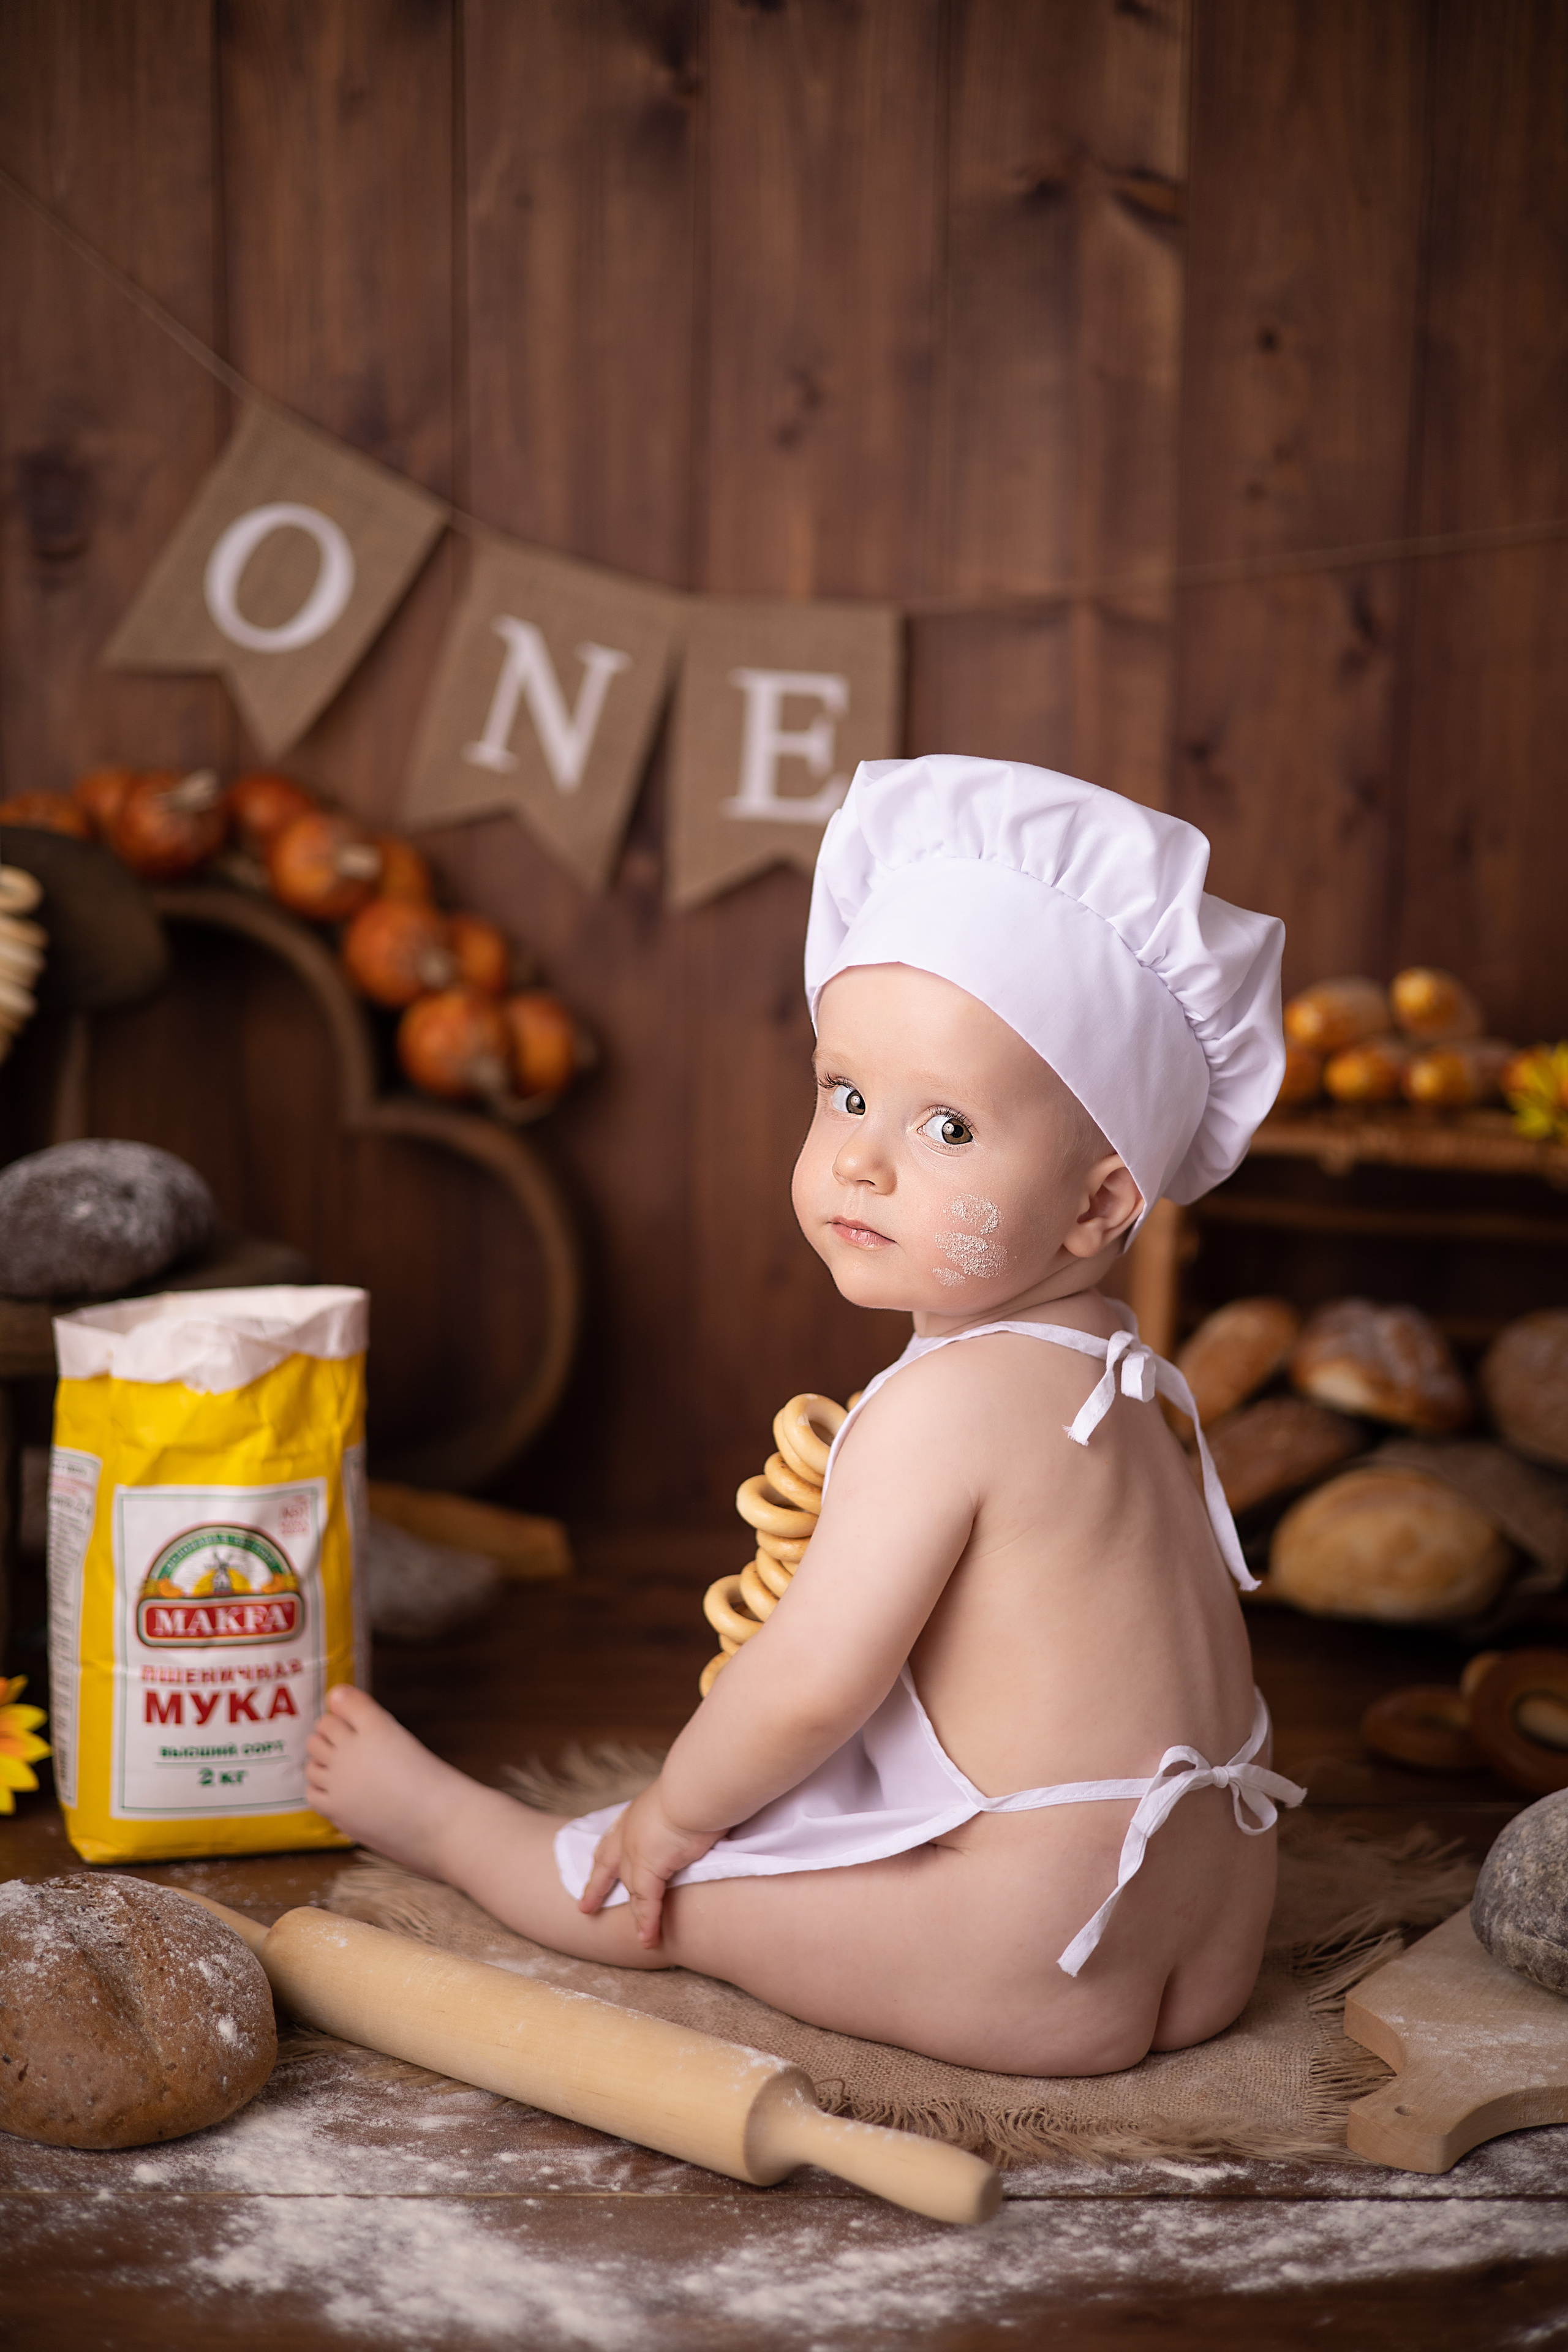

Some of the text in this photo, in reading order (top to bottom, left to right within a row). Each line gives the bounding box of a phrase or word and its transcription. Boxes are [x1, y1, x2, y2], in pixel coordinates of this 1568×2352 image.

[153, 1604, 288, 1636] MAKFA
[141, 1659, 303, 1683] ПШЕНИЧНАЯ
[145, 1685, 298, 1725] МУКА
[199, 1767, 214, 1785] 2
